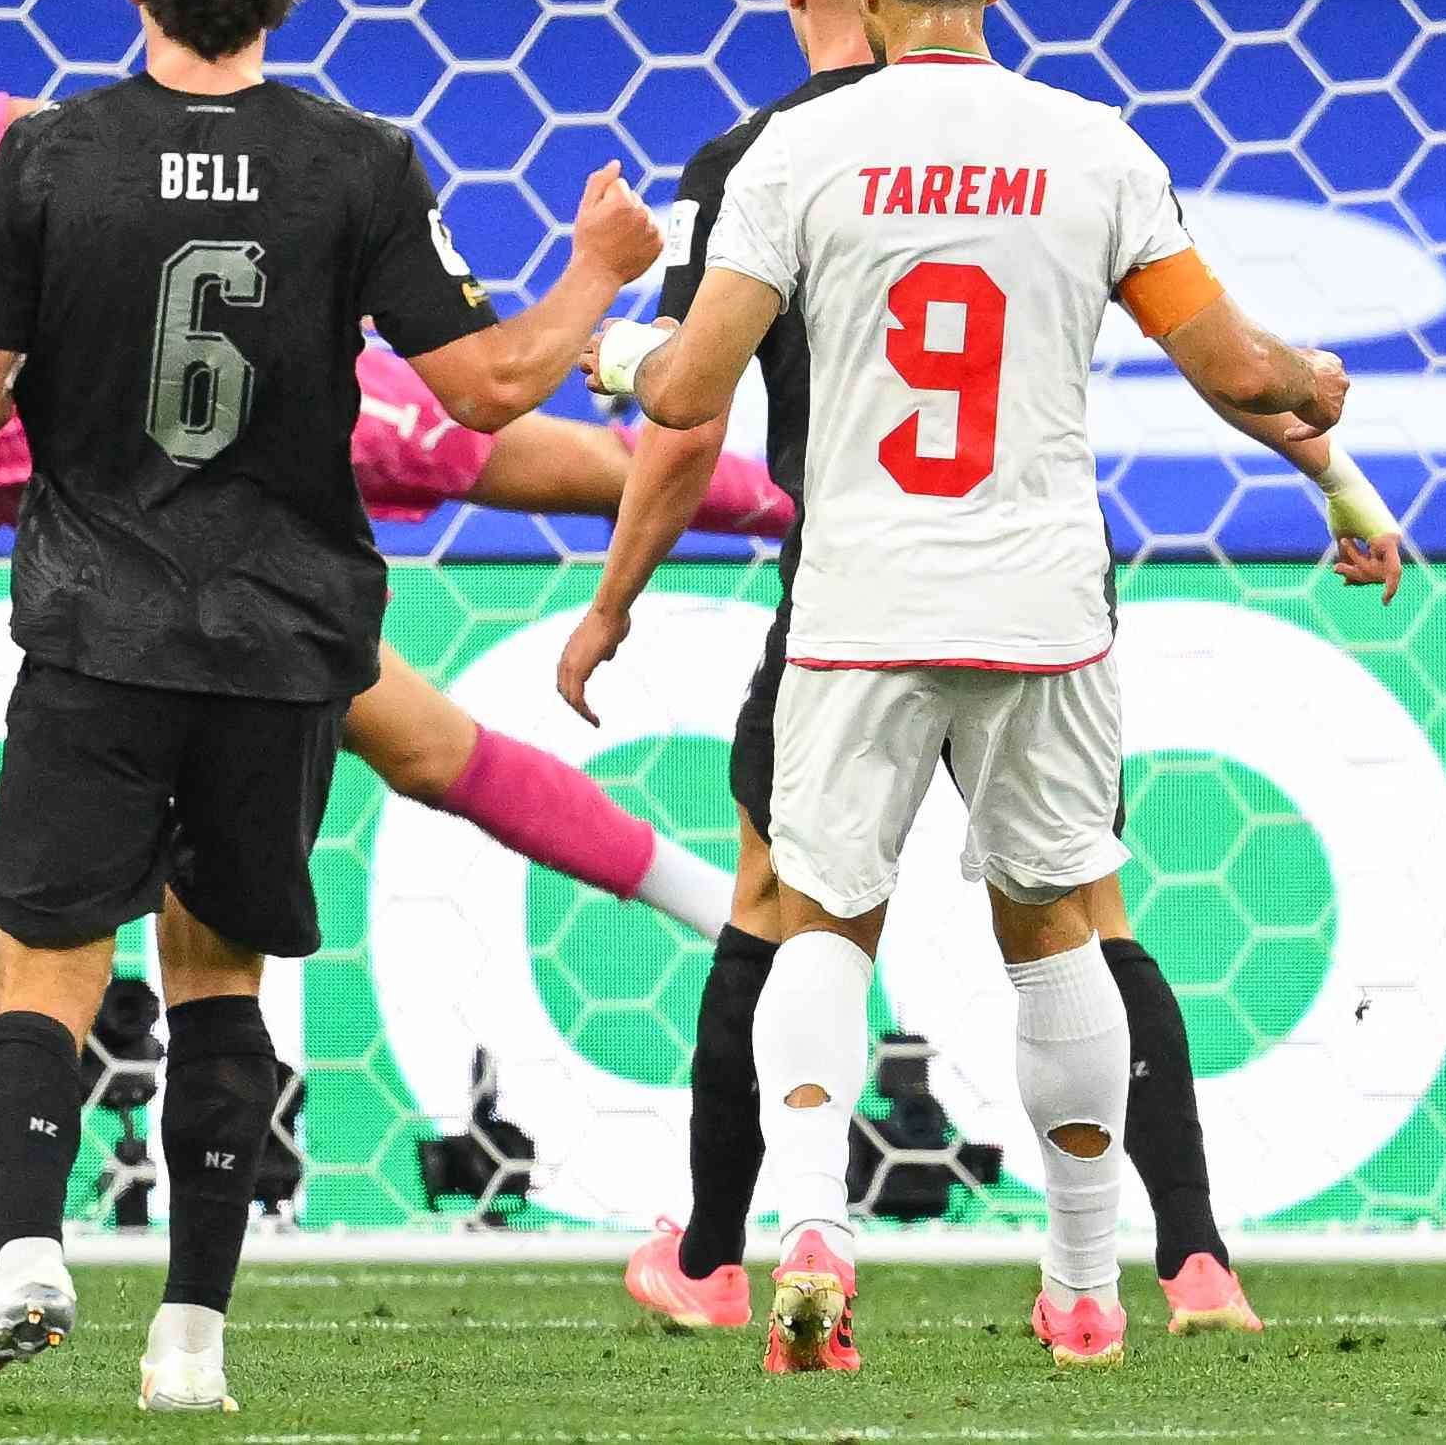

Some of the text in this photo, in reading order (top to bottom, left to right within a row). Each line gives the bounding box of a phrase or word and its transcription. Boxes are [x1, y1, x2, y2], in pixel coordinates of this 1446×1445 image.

[160, 153, 259, 202] BELL
[860, 166, 1048, 216] TAREMI
[146, 239, 268, 468] 6
[878, 262, 1007, 497] 9
[29, 1116, 60, 1138] NZ
[205, 1151, 236, 1170] NZ
